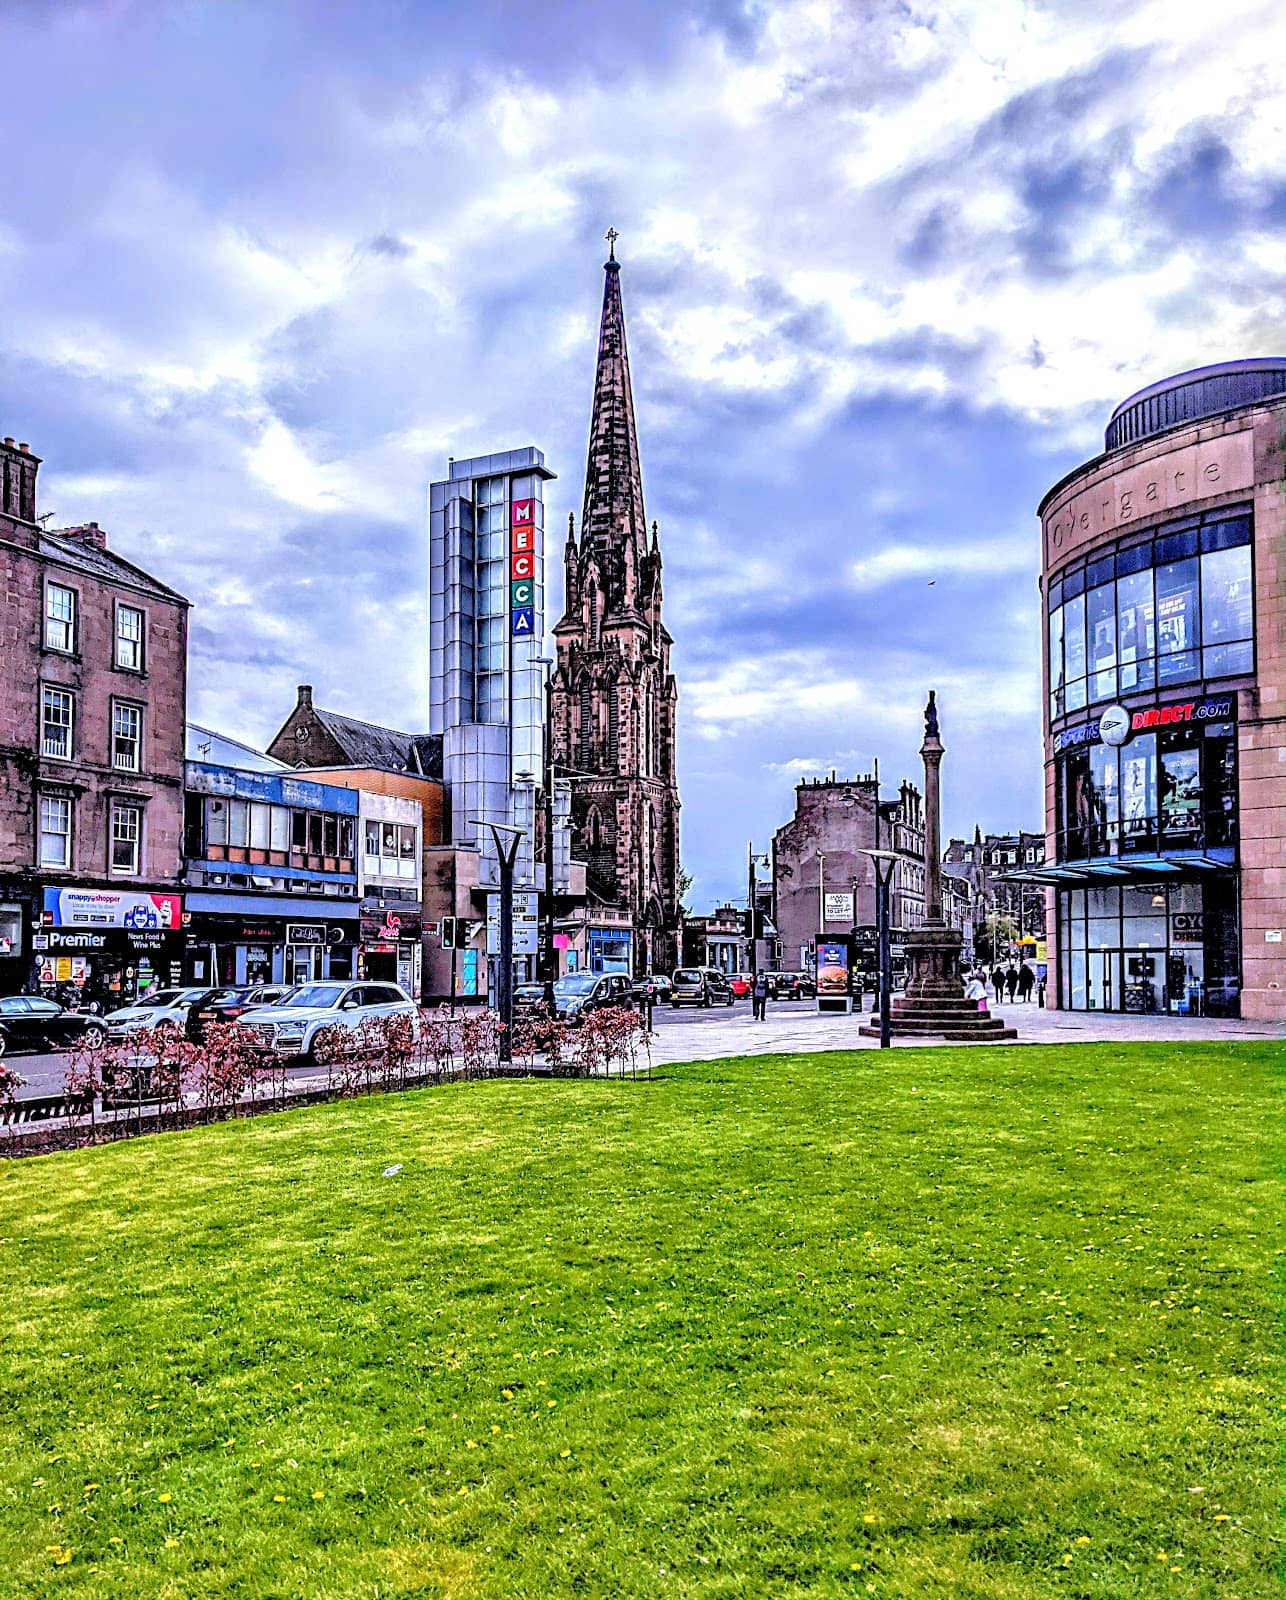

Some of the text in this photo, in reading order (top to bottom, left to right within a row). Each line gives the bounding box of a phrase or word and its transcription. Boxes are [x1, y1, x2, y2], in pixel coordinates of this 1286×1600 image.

[515, 503, 530, 630] MECCA
[50, 932, 106, 947] Premier
[145, 932, 160, 941] Food
[133, 940, 149, 949] Wine
